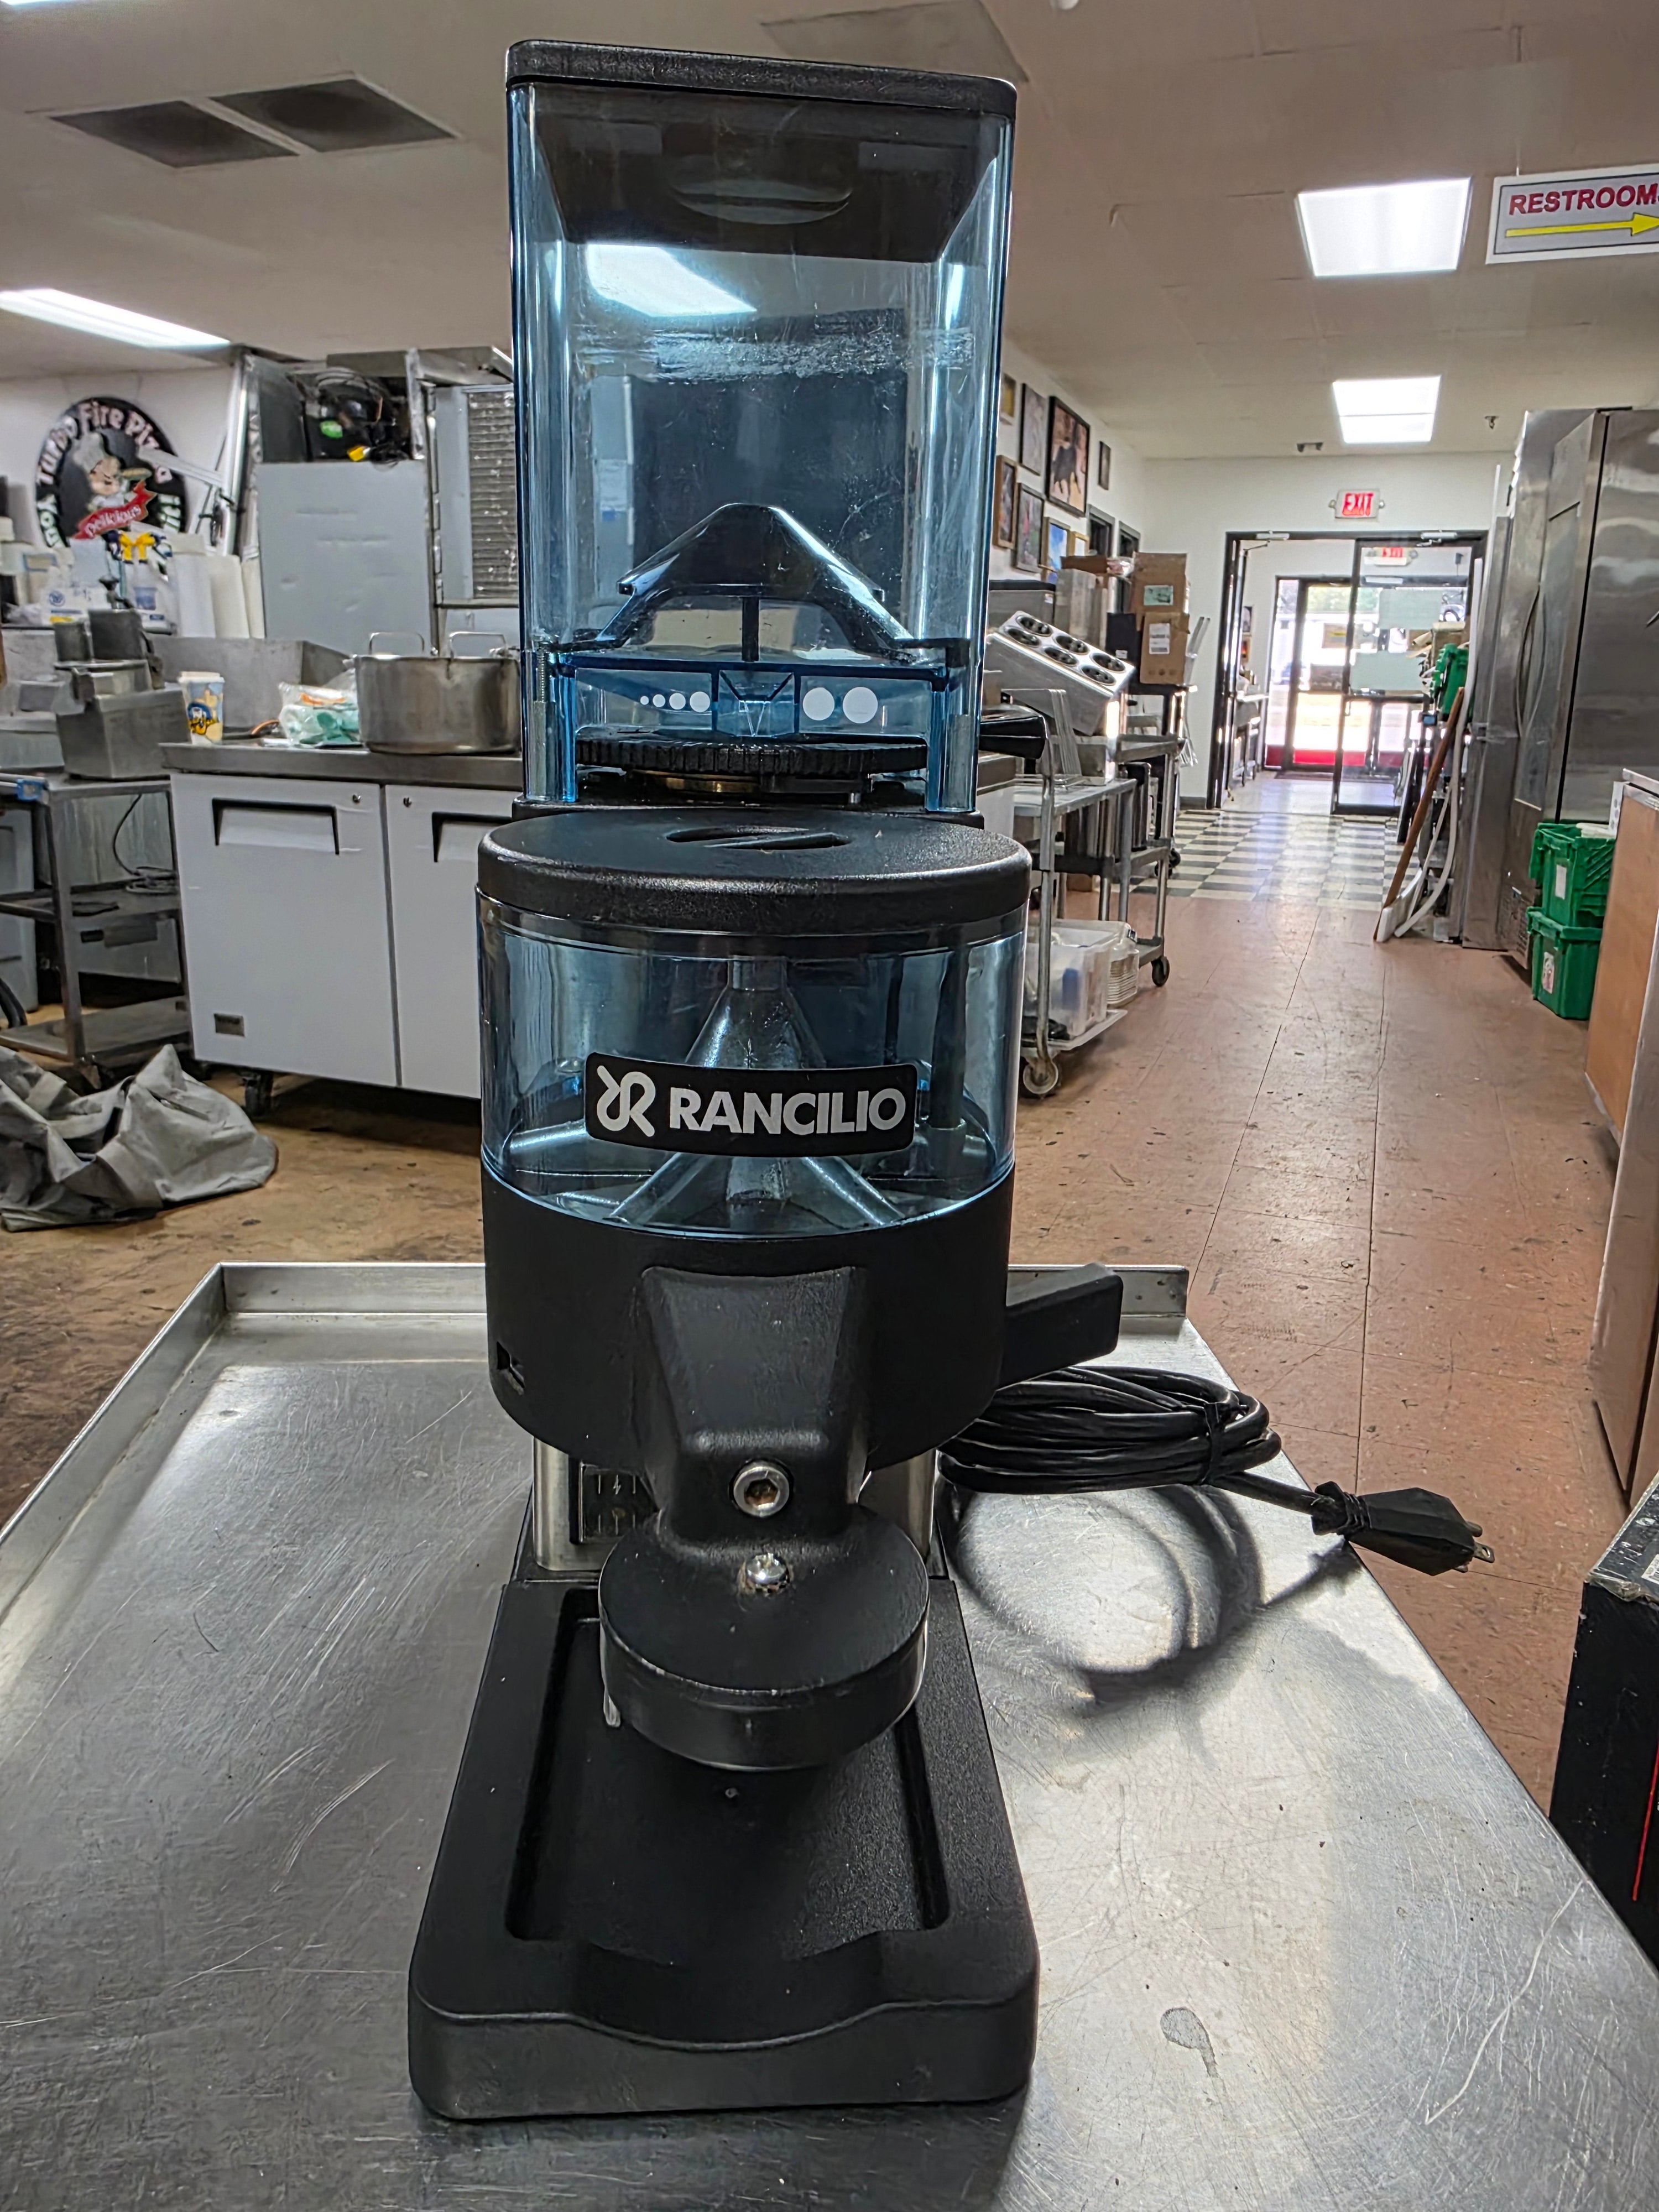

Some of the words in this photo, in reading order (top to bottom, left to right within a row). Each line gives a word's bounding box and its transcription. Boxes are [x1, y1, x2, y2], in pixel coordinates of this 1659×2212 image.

[1509, 183, 1659, 215] RESTROOM
[1342, 492, 1374, 516] EXIT
[669, 1087, 906, 1135] RANCILIO
